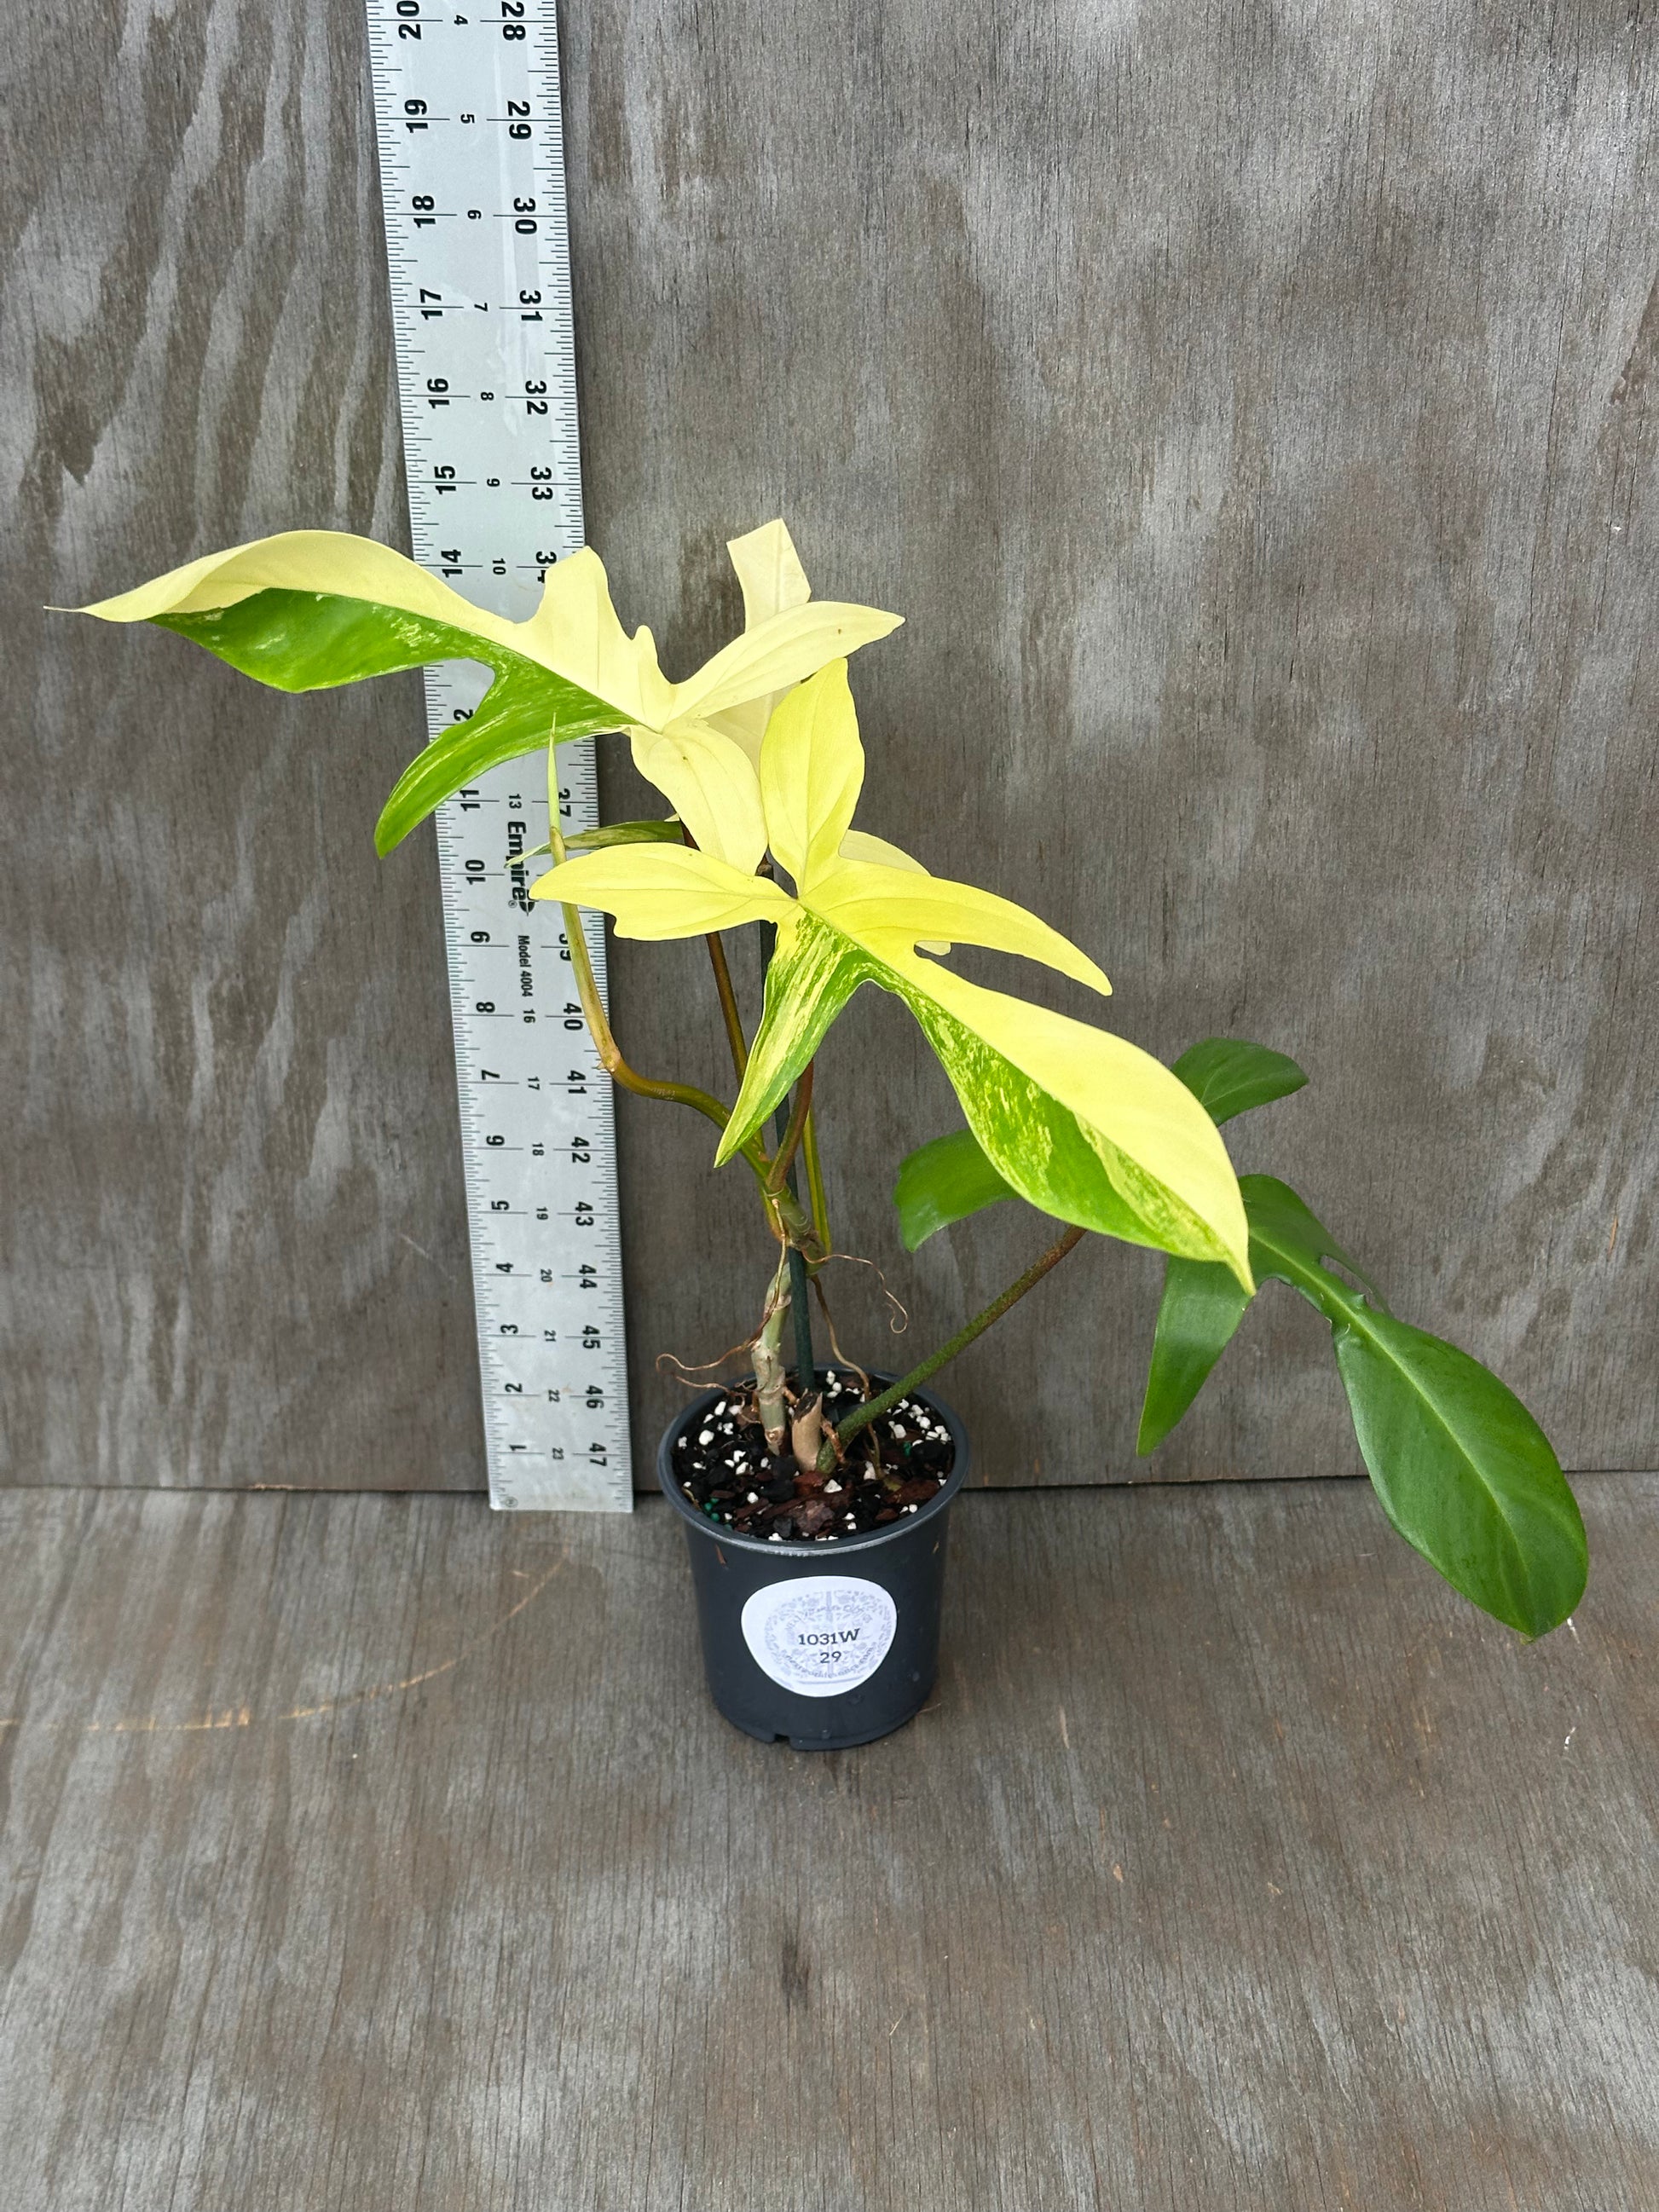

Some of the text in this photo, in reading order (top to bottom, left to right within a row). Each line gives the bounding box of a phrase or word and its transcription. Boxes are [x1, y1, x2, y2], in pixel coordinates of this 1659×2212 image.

[396, 0, 421, 40] 20
[454, 15, 468, 26] 4
[501, 2, 526, 41] 28
[404, 99, 429, 134] 19
[460, 113, 475, 124] 5
[507, 101, 532, 140] 29
[412, 195, 436, 228] 18
[467, 210, 482, 220] 6
[513, 198, 538, 234] 30
[419, 288, 443, 321] 17
[474, 303, 488, 312] 7
[519, 290, 543, 321] 31
[427, 378, 450, 409] 16
[480, 391, 494, 401] 8
[525, 380, 548, 415] 32
[434, 465, 457, 494] 15
[486, 478, 500, 487] 9
[530, 466, 553, 500] 33
[441, 549, 463, 578] 14
[492, 557, 506, 575] 10
[460, 789, 480, 811] 11
[509, 794, 522, 809] 13
[465, 859, 485, 885] 10
[471, 931, 490, 943] 9
[517, 935, 533, 997] Model 4004
[476, 1002, 495, 1013] 8
[523, 1009, 535, 1023] 16
[564, 1002, 583, 1031] 40
[481, 1070, 500, 1080] 7
[528, 1077, 540, 1090] 17
[567, 1070, 587, 1094] 41
[486, 1135, 505, 1146] 6
[532, 1143, 544, 1156] 18
[571, 1136, 591, 1164] 42
[491, 1200, 510, 1210] 5
[536, 1207, 548, 1220] 19
[575, 1202, 593, 1227] 43
[495, 1262, 513, 1273] 4
[540, 1268, 552, 1282] 20
[579, 1264, 597, 1289] 44
[500, 1324, 518, 1334] 3
[544, 1330, 557, 1343] 21
[582, 1325, 600, 1349] 45
[505, 1383, 523, 1393] 2
[548, 1389, 560, 1402] 22
[586, 1385, 604, 1409] 46
[552, 1447, 564, 1461] 23
[589, 1442, 607, 1467] 47
[798, 1628, 860, 1646] 1031W
[819, 1651, 841, 1663] 29
